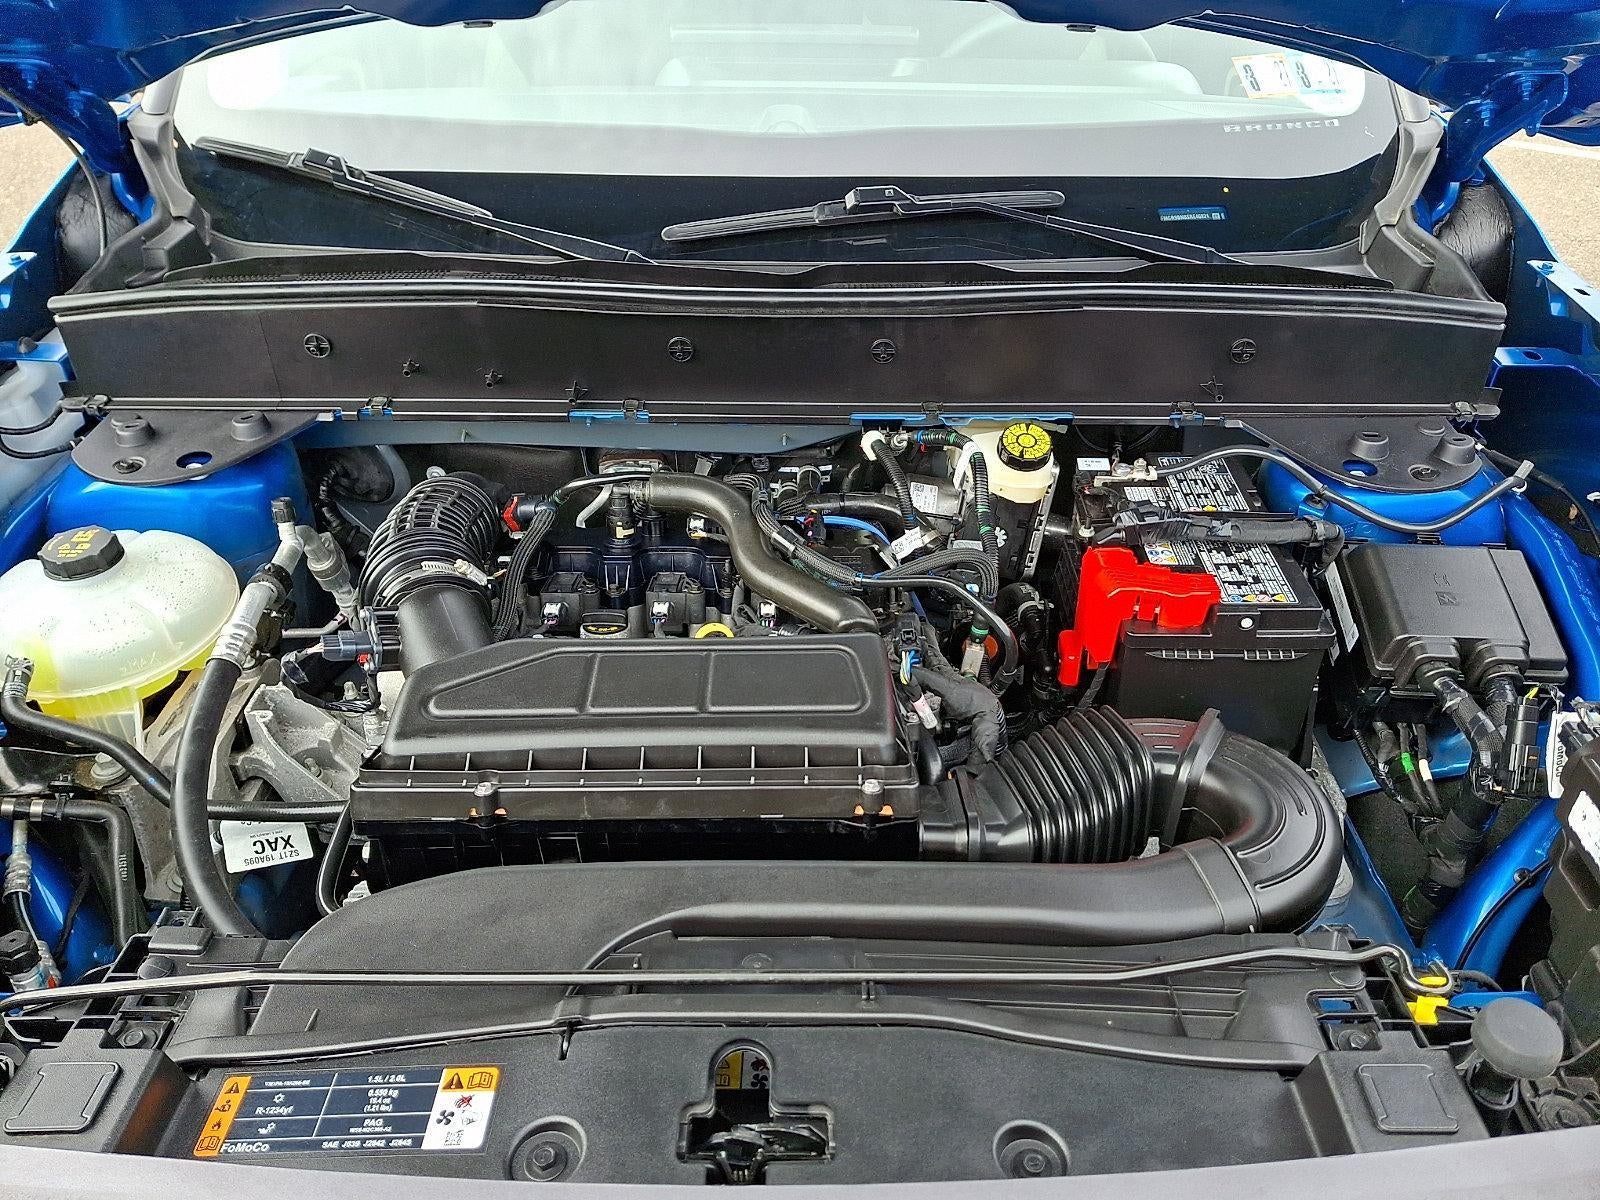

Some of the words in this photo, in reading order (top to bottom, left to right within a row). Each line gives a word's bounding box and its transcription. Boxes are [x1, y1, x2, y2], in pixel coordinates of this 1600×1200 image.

[1223, 118, 1339, 133] BRONCO
[252, 834, 295, 855] XAC
[244, 853, 275, 867] 19A095
[388, 1088, 399, 1098] kg
[255, 1105, 294, 1115] R-1234yf
[363, 1118, 384, 1127] PAG
[220, 1142, 271, 1153] FoMoCo
[321, 1141, 339, 1149] SAE
